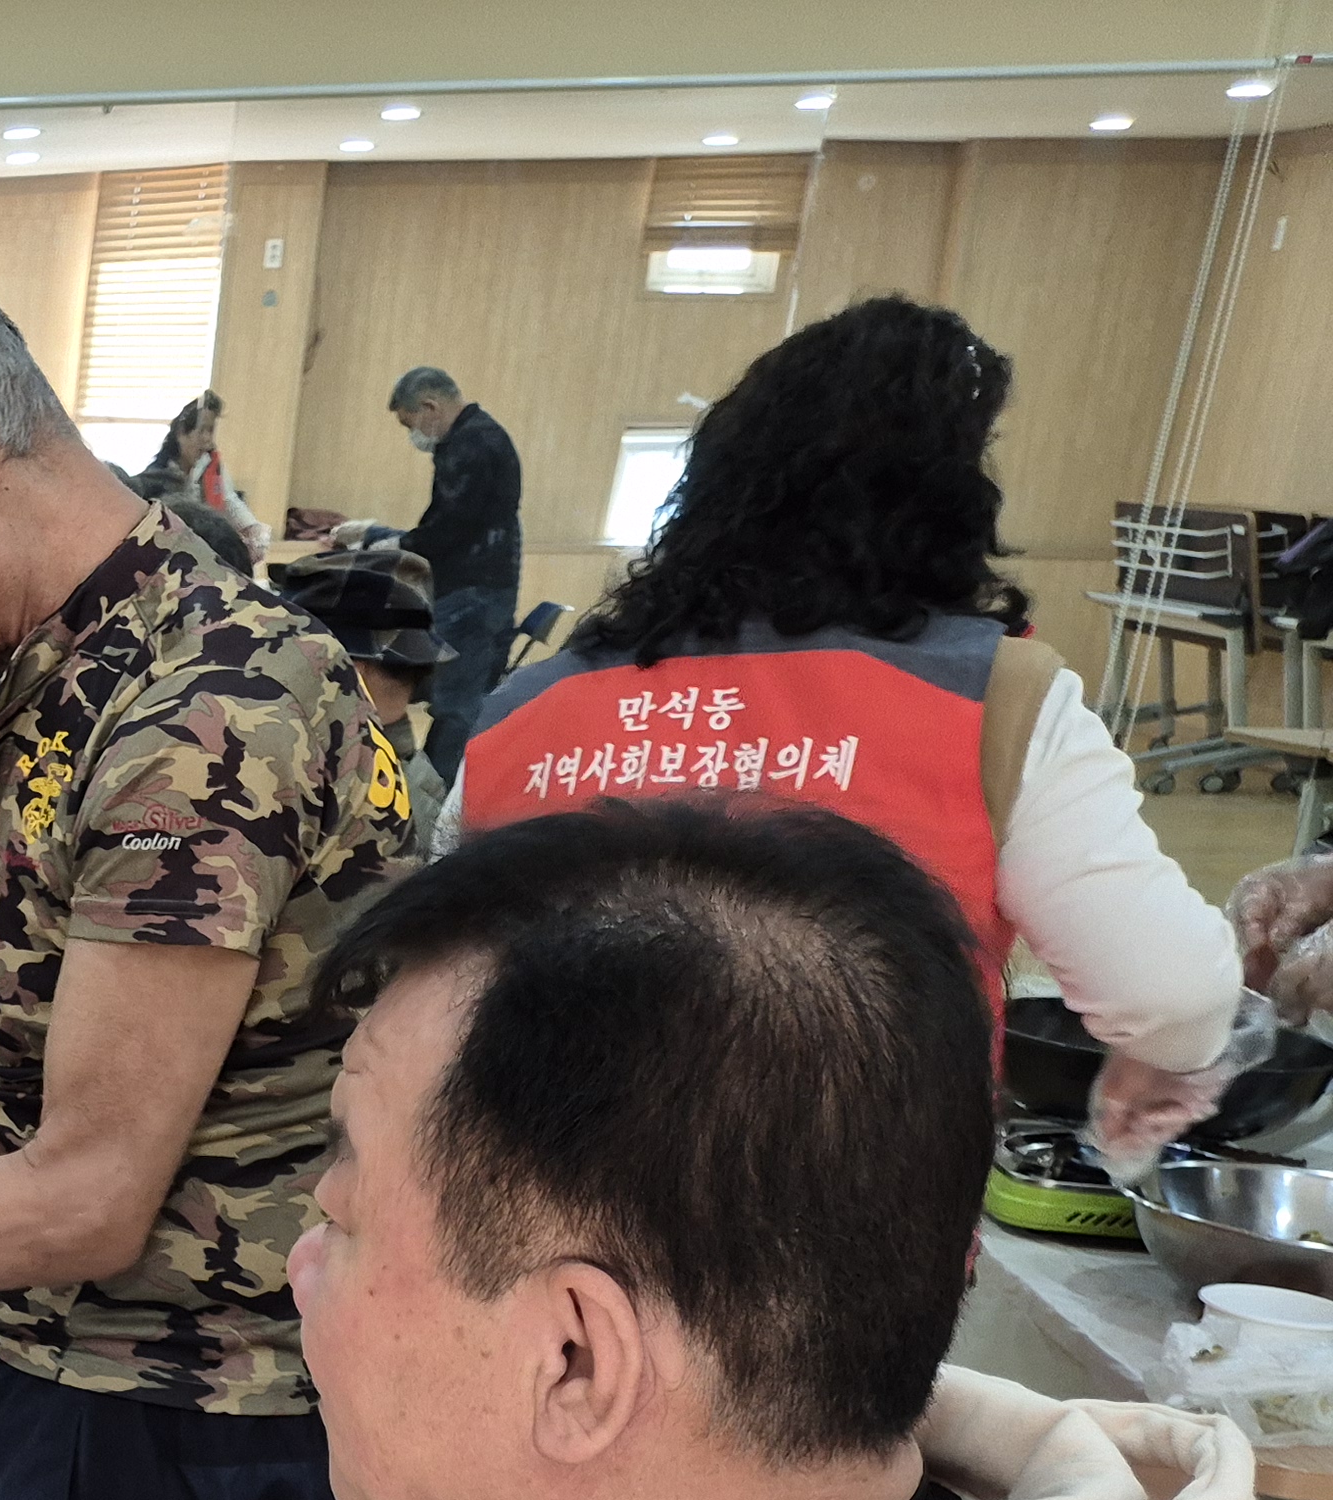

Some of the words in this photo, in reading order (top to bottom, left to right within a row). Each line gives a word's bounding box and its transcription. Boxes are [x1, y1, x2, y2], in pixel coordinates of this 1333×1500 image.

[618, 686, 746, 731] 만석동
[523, 735, 860, 799] 지역사회보장협의체
[143, 804, 208, 831] Silver
[121, 833, 182, 851] Coolon
